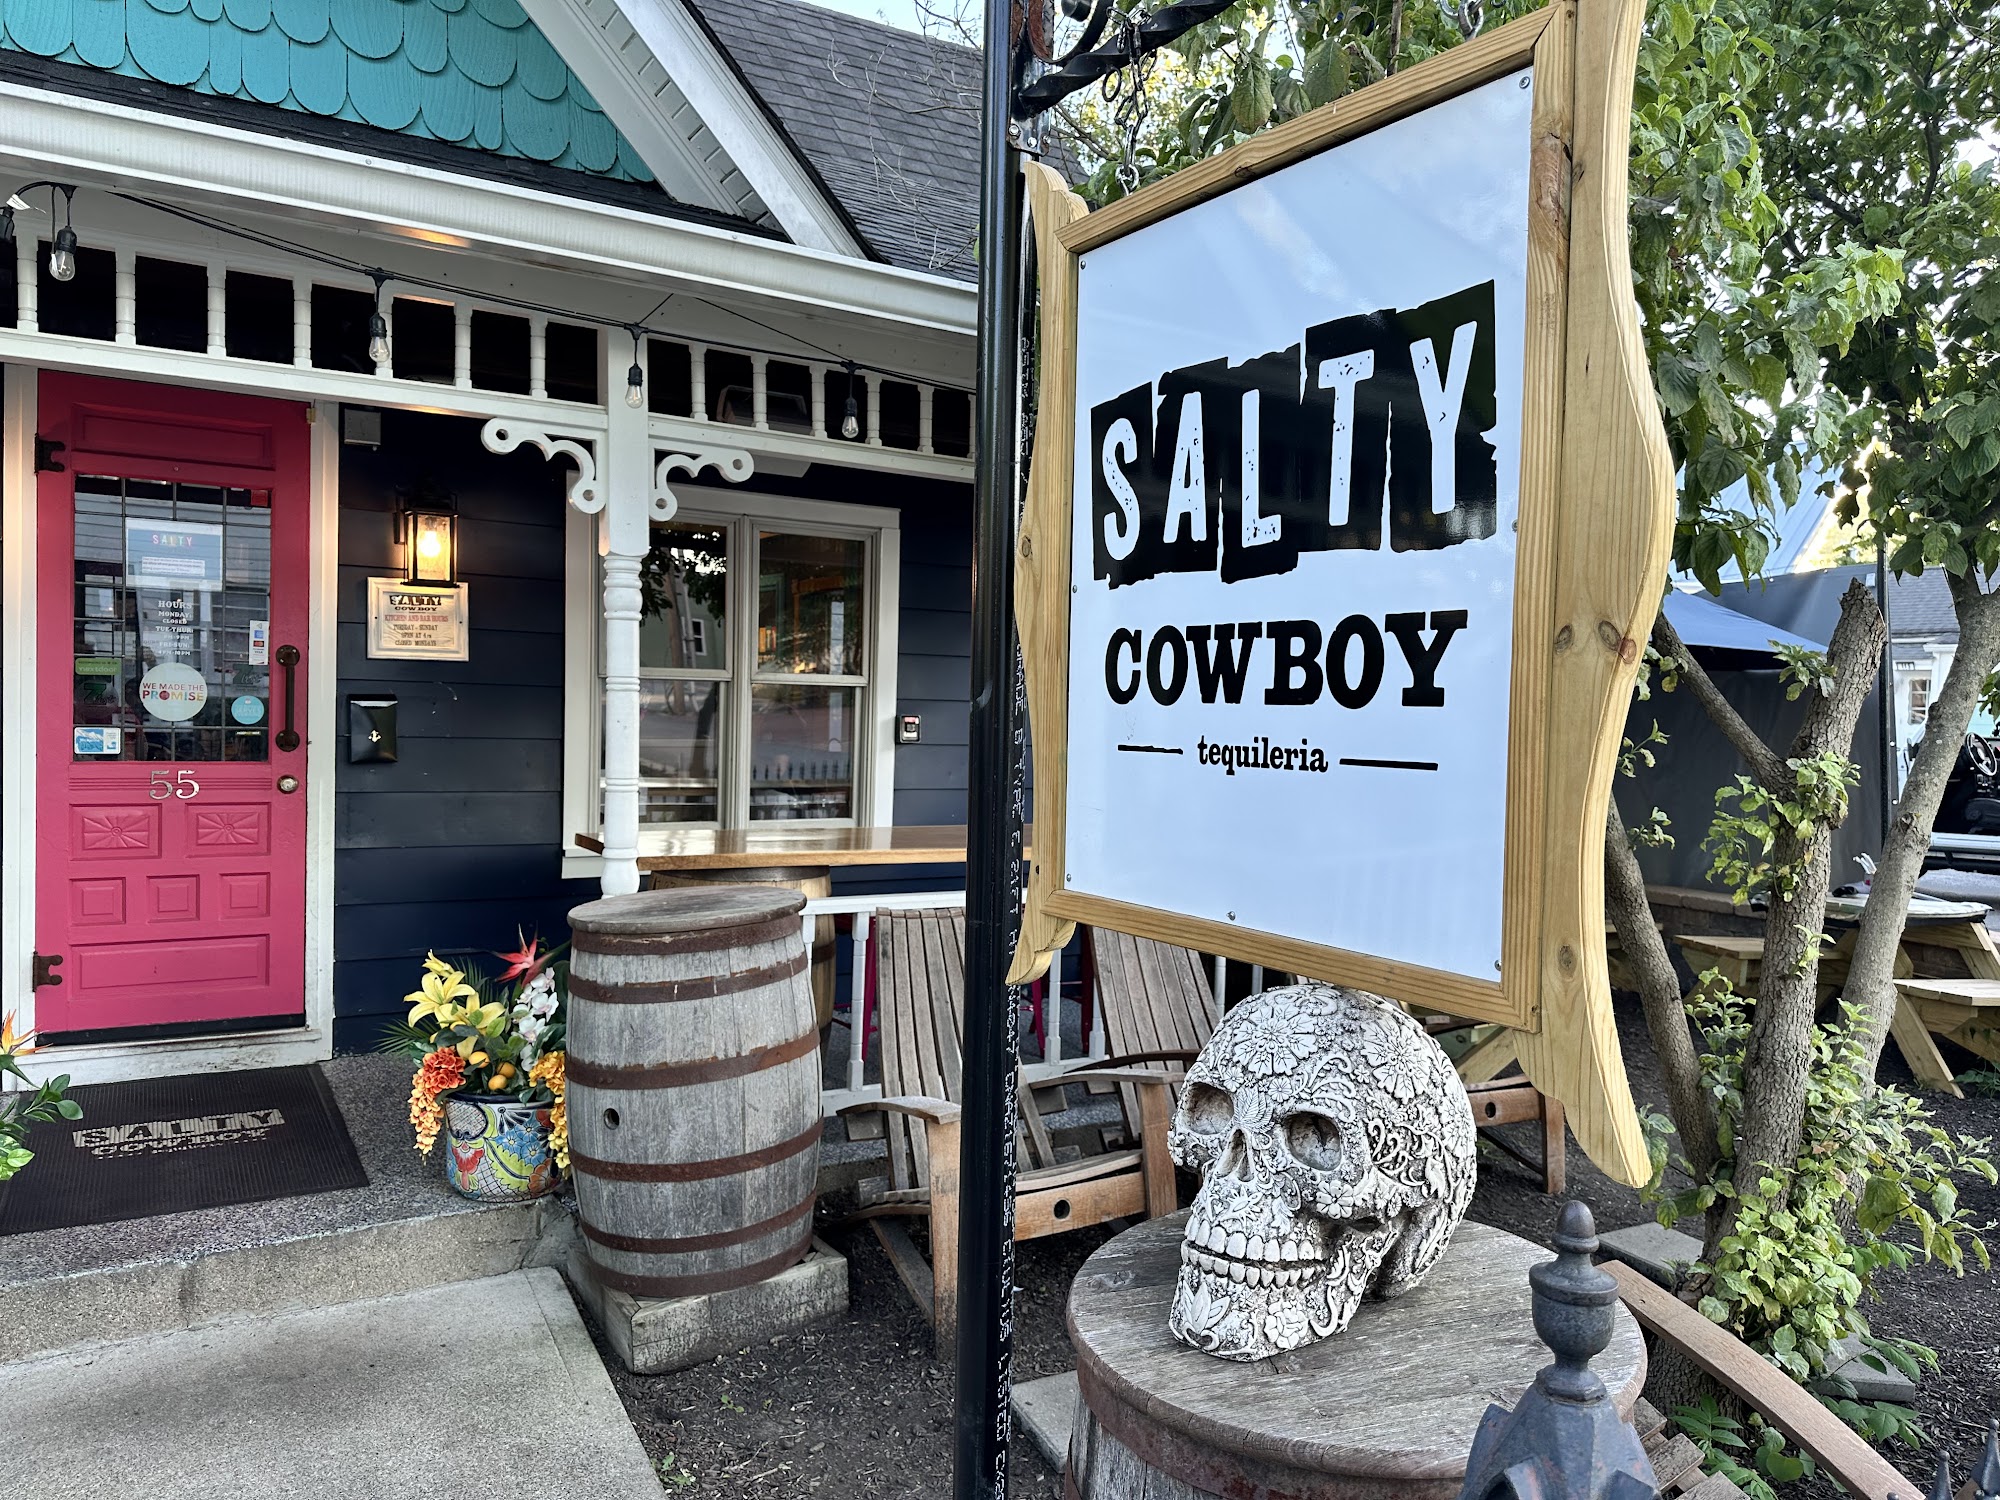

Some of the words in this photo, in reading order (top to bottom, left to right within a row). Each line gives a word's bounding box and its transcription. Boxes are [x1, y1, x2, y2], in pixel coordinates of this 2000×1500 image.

[1102, 321, 1478, 561] SALTY
[153, 534, 192, 546] SALTY
[158, 600, 192, 609] HOURS
[390, 595, 440, 605] SALTY
[1105, 610, 1468, 709] COWBOY
[142, 690, 203, 701] PROMISE
[1197, 735, 1328, 775] tequileria
[149, 770, 199, 800] 55
[1011, 758, 1022, 819] TYPE
[80, 1110, 276, 1146] SALTY
[996, 1352, 1008, 1441] LISTED
